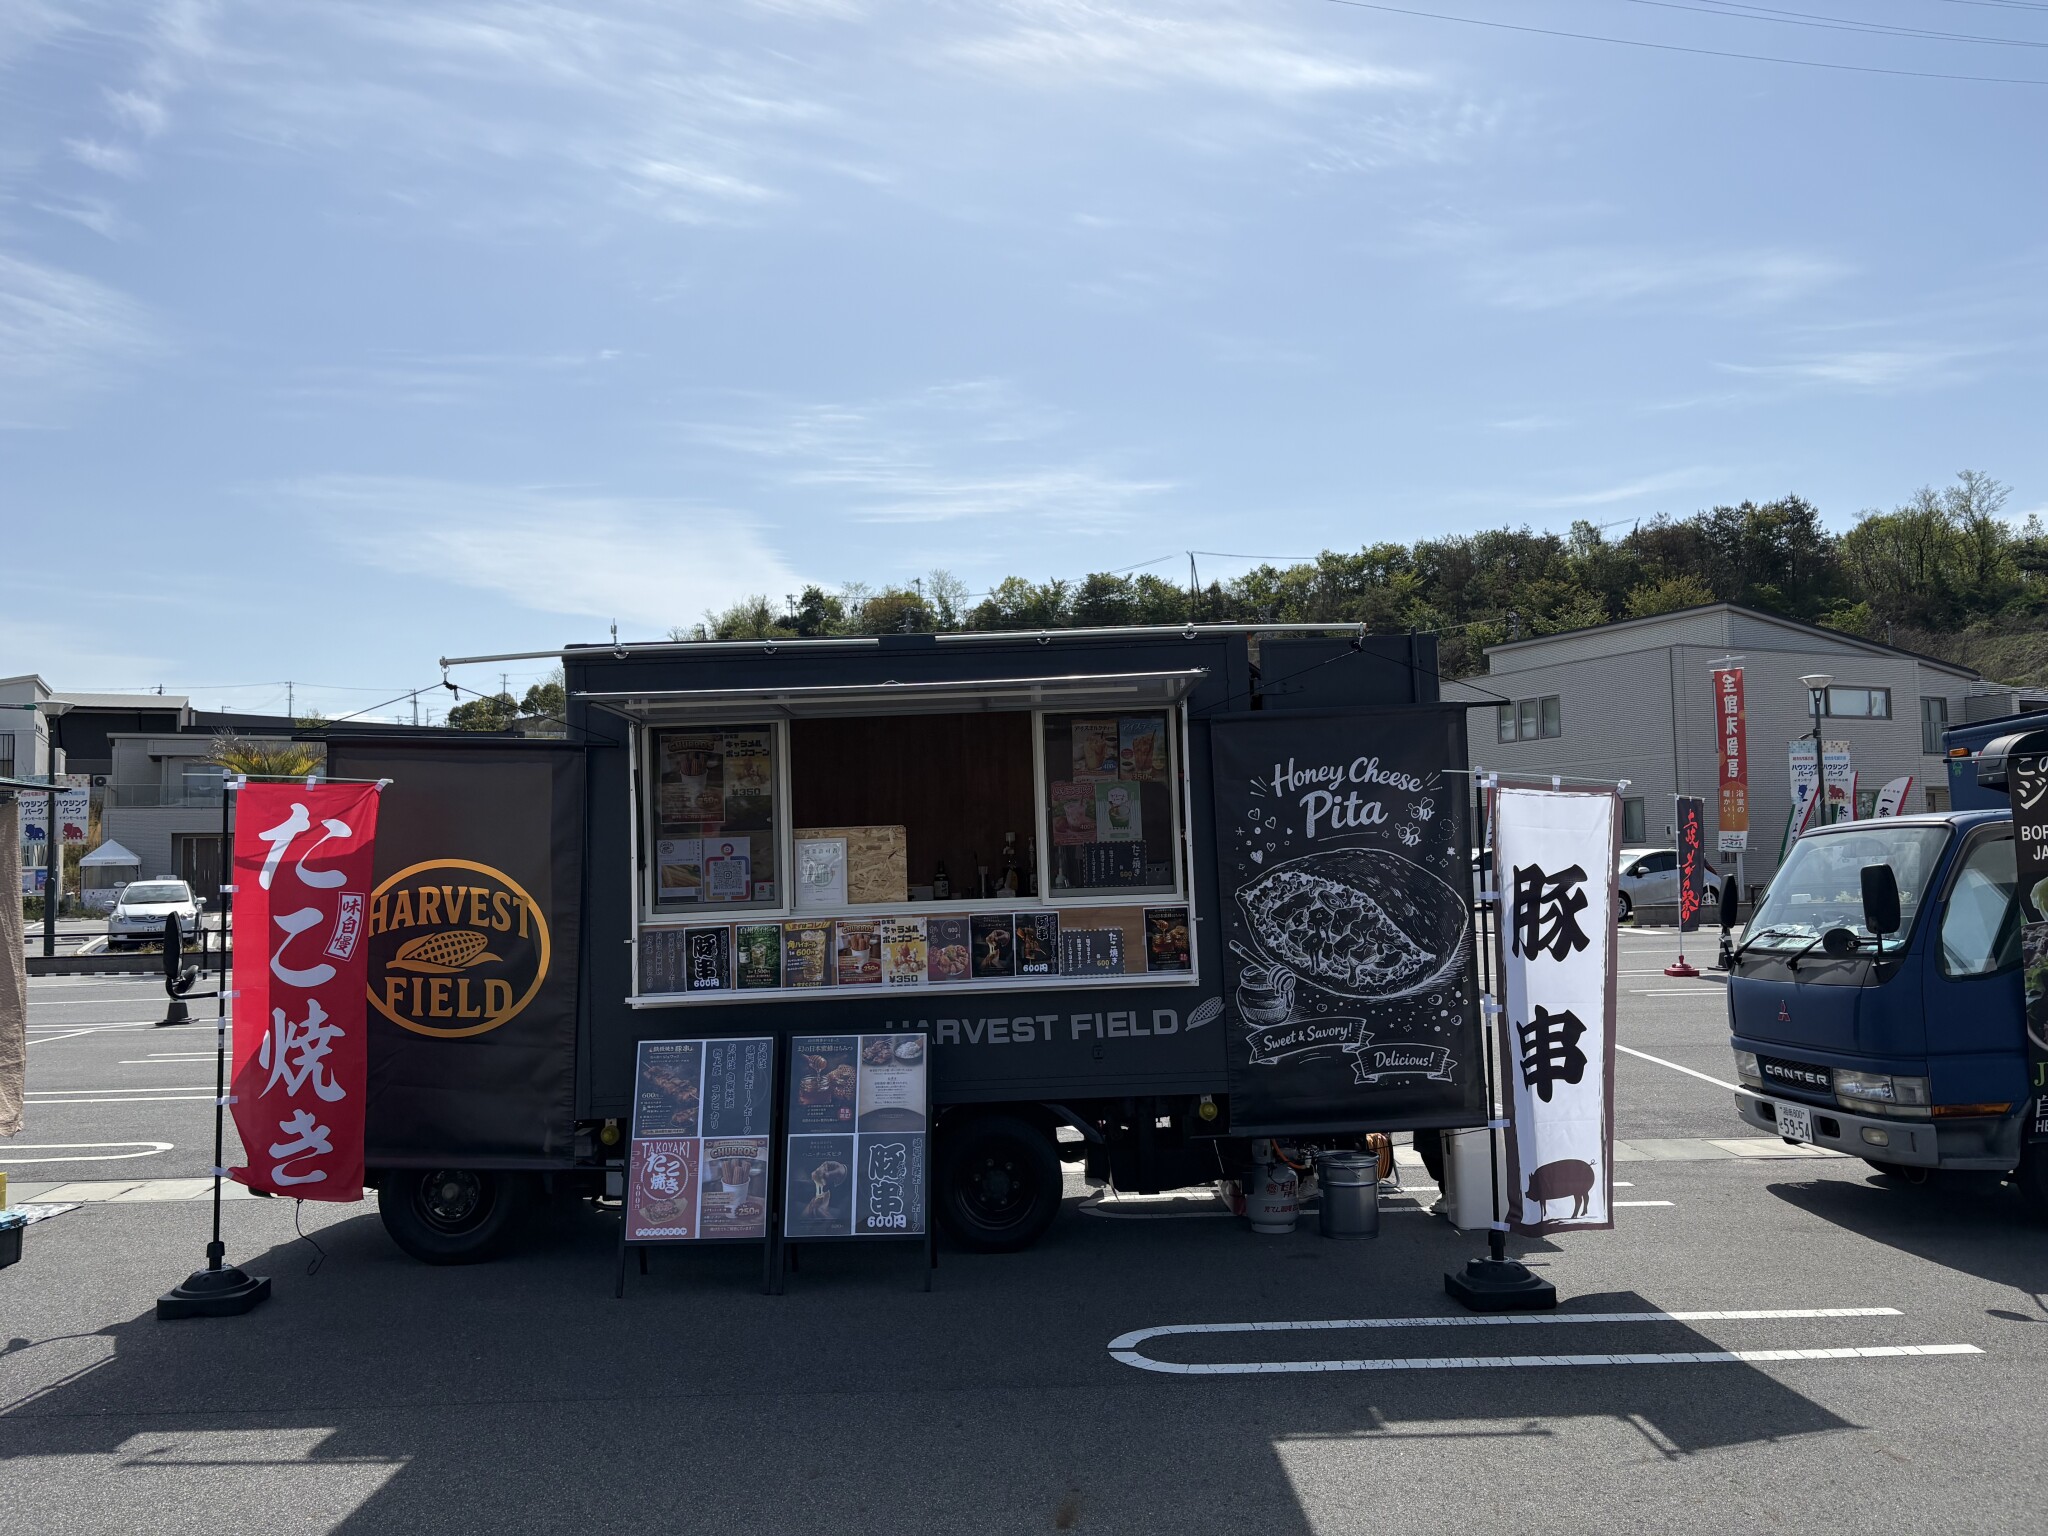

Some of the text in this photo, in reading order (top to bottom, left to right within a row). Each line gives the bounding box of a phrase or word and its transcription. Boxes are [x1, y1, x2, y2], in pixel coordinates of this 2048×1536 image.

[1721, 673, 1740, 778] 全館床暖房
[725, 739, 762, 748] キャラメル
[1270, 756, 1425, 798] Honey Cheese
[1299, 790, 1390, 839] Pita
[1131, 844, 1141, 877] たこ焼き
[368, 885, 530, 939] HARVEST
[333, 896, 362, 954] 味自慢
[842, 925, 875, 934] CHURROS
[882, 925, 919, 934] キャラメル
[882, 934, 927, 944] ポップコーン
[1108, 932, 1119, 966] たこ焼き
[889, 974, 918, 983] ¥350
[1023, 963, 1048, 973] 600円
[693, 978, 719, 988] 600円
[1511, 863, 1592, 1104] 豚串
[258, 803, 353, 1187] たこ焼き
[384, 976, 515, 1019] FIELD
[886, 1009, 1179, 1045] RVEST FIELD
[1264, 1022, 1354, 1052] Sweet & Savory!
[1373, 1051, 1436, 1069] Delicious!
[1765, 1064, 1831, 1087] CANTER
[1783, 1117, 1811, 1140] 59-54
[641, 1141, 690, 1159] TAKOYAKI
[711, 1147, 758, 1159] CHURROS
[647, 1152, 680, 1177] たこ
[650, 1173, 679, 1195] 焼き
[867, 1214, 907, 1229] 600円
